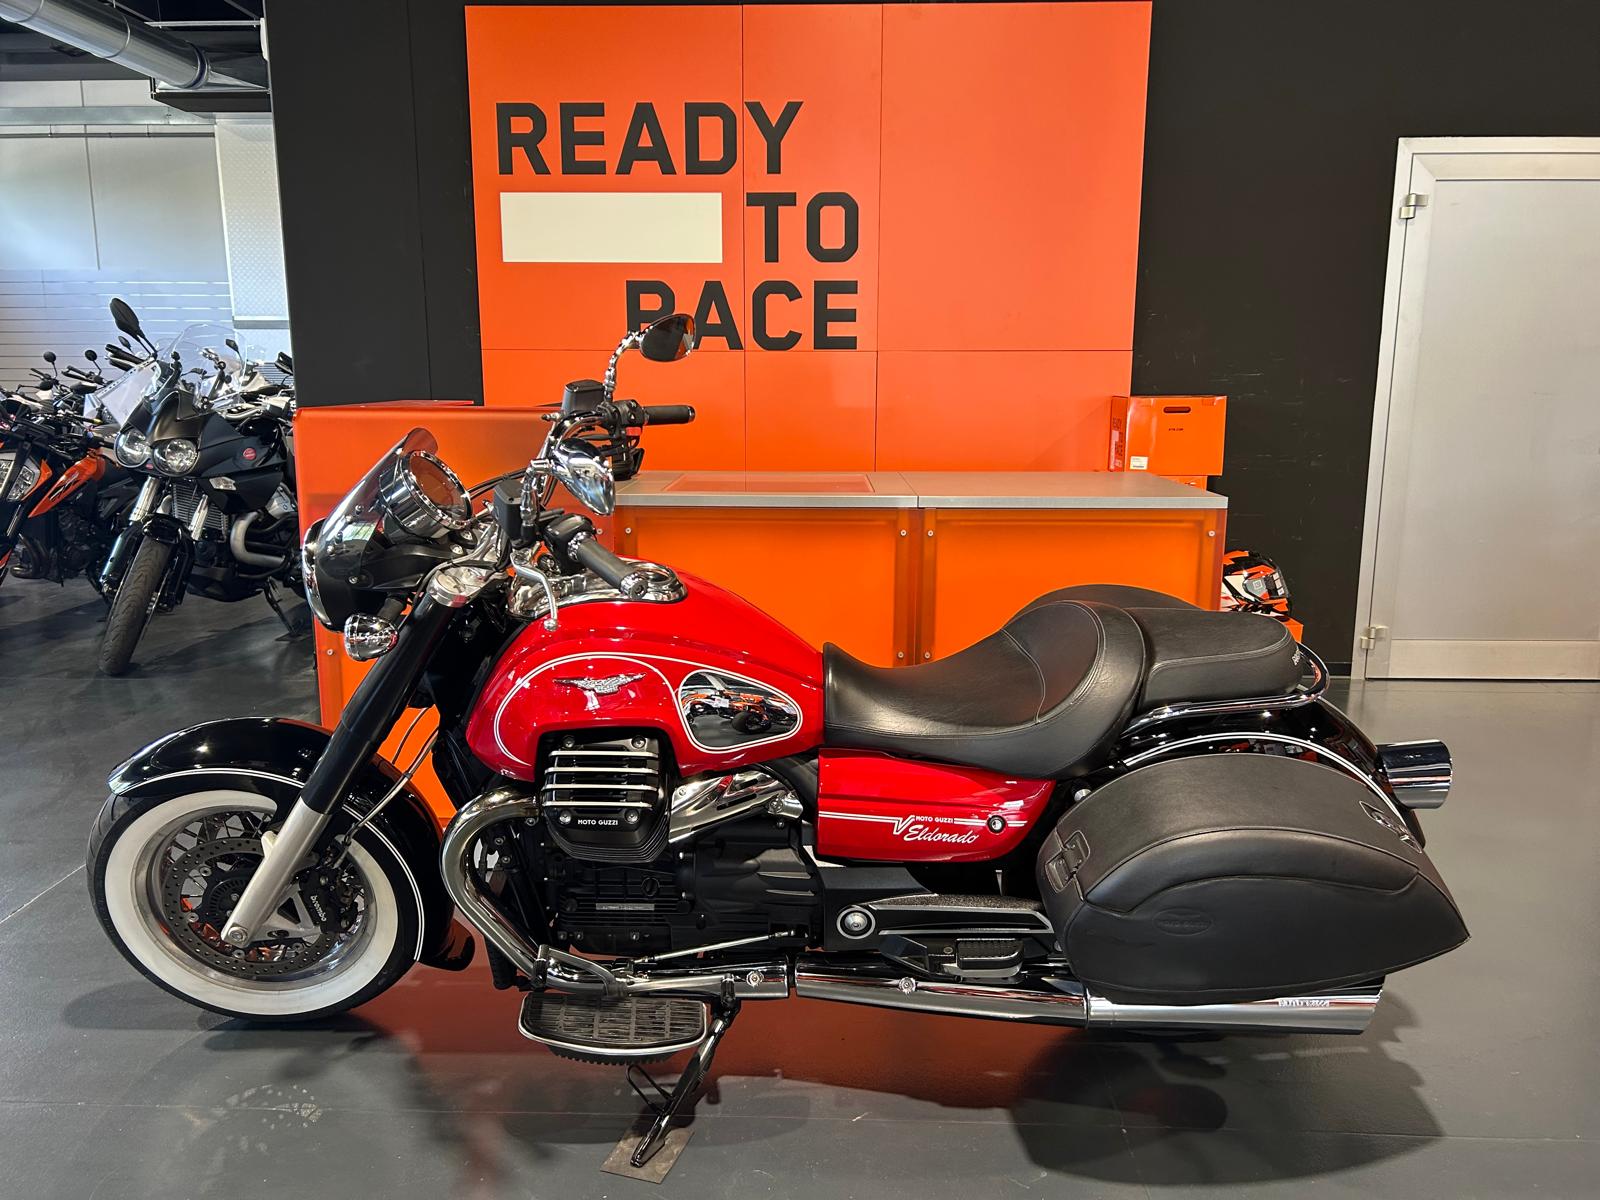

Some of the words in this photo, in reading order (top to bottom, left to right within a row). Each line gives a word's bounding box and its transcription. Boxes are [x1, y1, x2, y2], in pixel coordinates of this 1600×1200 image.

[496, 101, 804, 175] READY
[746, 191, 859, 263] TO
[626, 279, 859, 351] RACE
[903, 824, 979, 843] Eldorado
[310, 895, 326, 921] brembo
